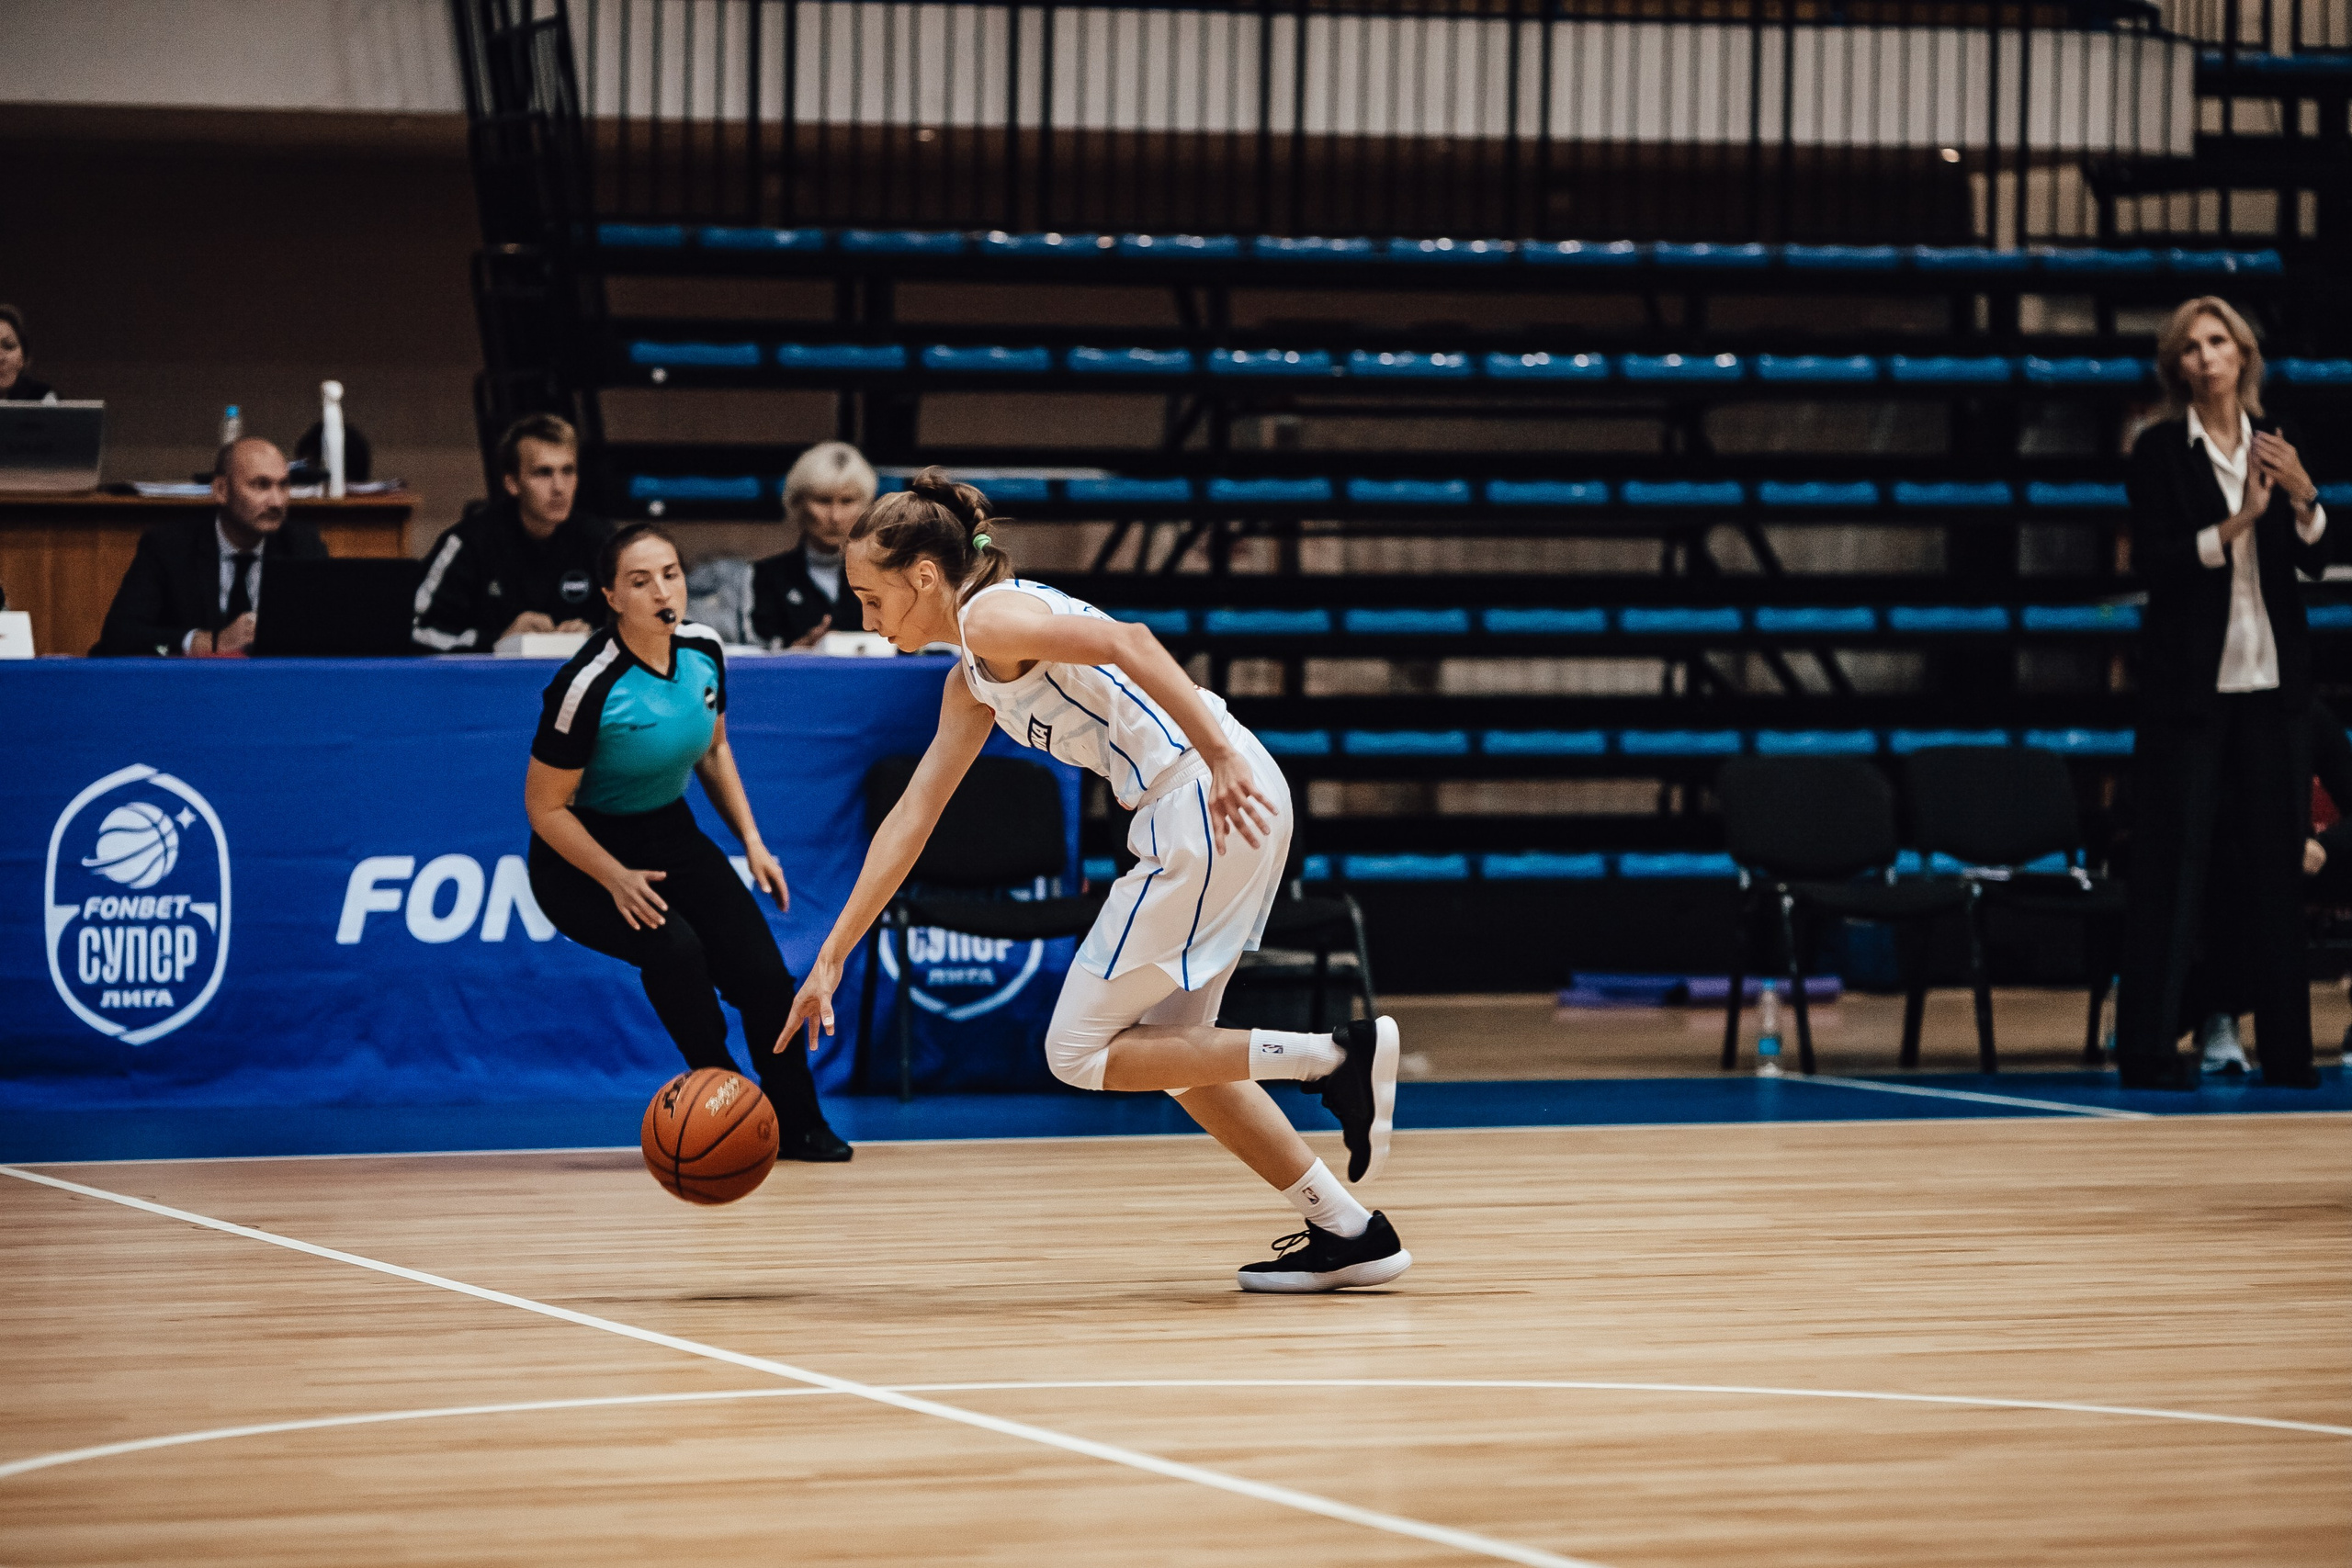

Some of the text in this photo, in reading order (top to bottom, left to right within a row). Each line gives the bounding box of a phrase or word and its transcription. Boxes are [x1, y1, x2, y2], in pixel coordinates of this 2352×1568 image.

[83, 895, 191, 919] FONBET
[336, 853, 572, 943] FON
[78, 925, 198, 984] СУПЕР
[100, 989, 175, 1008] ЛИГА
